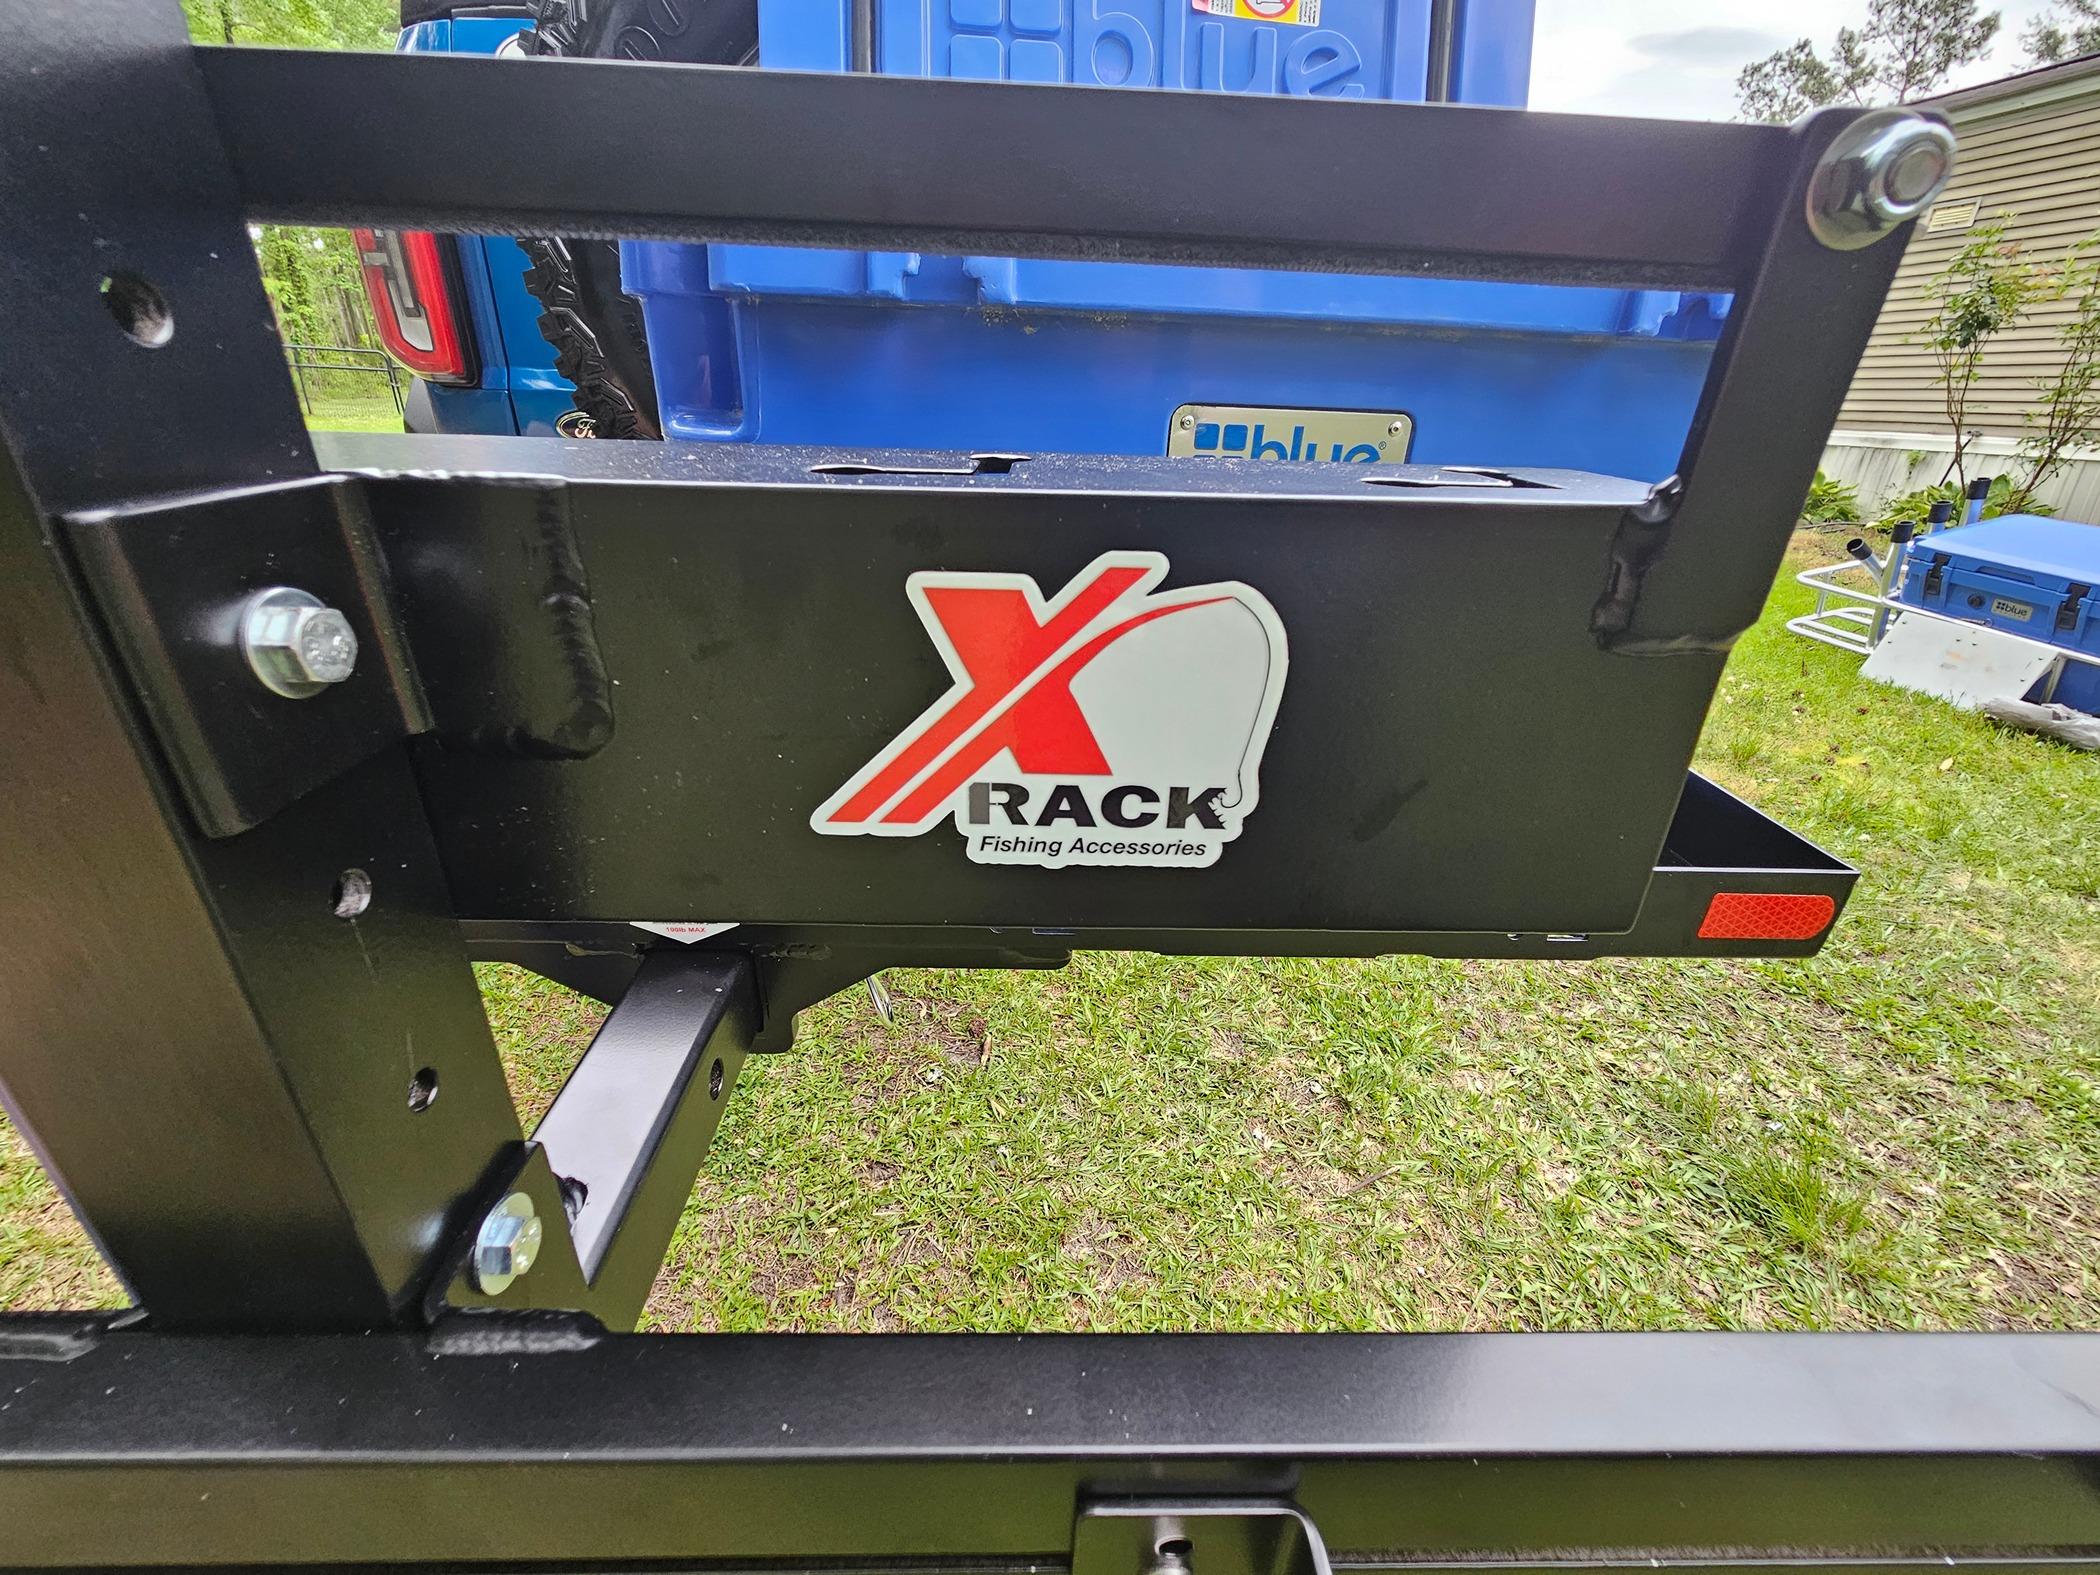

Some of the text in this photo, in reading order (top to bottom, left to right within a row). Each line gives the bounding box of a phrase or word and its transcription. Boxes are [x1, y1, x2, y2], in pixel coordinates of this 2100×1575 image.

[1072, 0, 1363, 99] blue
[2005, 605, 2028, 616] blue
[968, 782, 1227, 830] RACK
[979, 836, 1207, 856] Fishing Accessories
